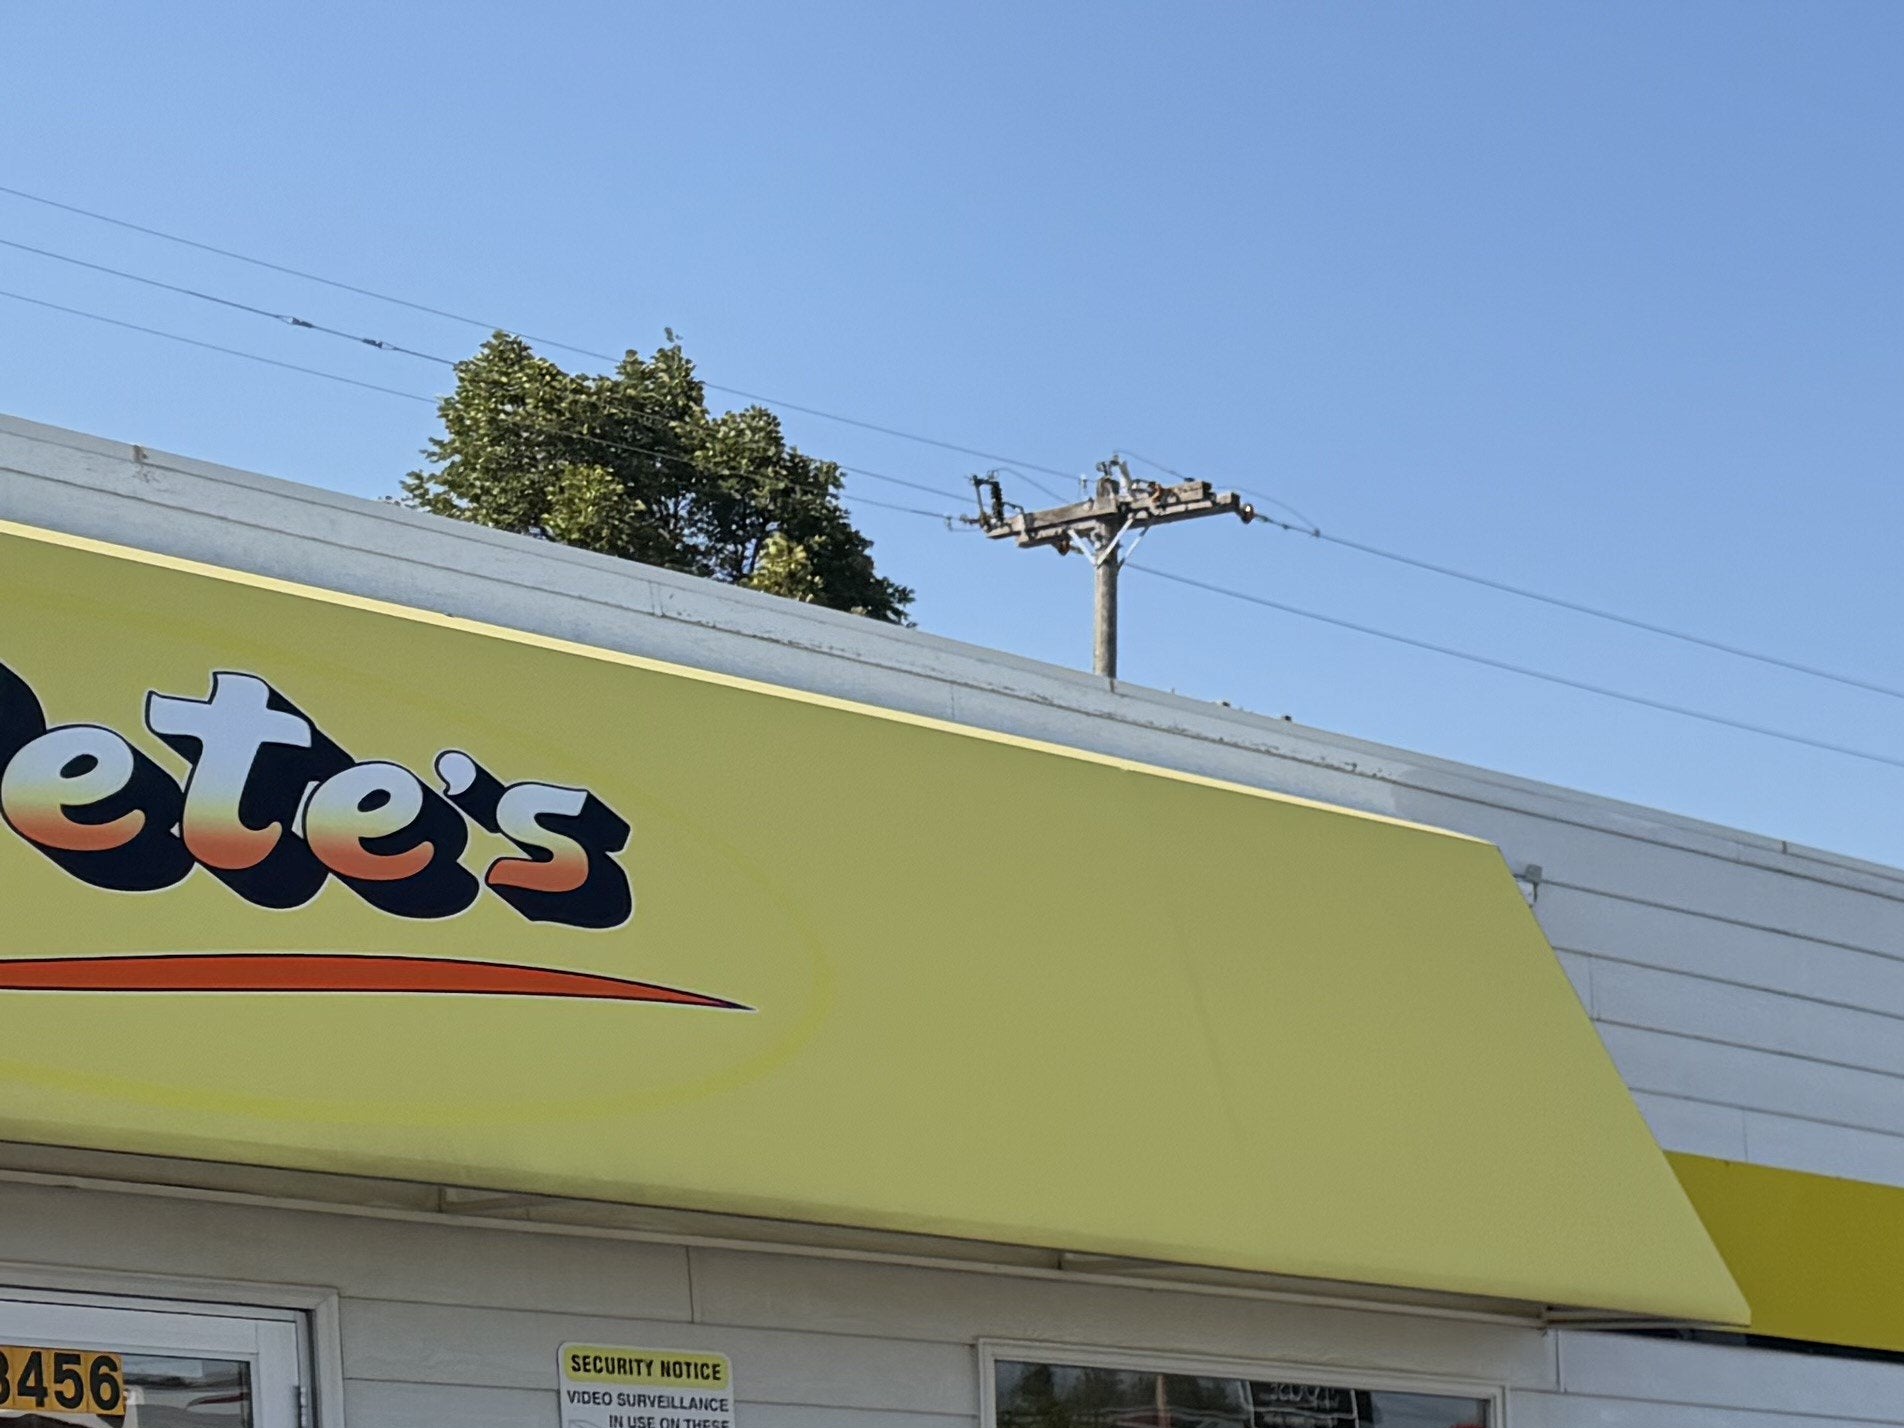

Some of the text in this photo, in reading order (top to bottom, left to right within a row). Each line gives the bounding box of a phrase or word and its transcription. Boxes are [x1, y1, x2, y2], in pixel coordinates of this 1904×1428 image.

[0, 668, 632, 928] ete's
[571, 1354, 721, 1381] SECURITY NOTICE
[567, 1390, 729, 1412] VIDEO SURVEILLANCE
[609, 1414, 623, 1428] IN
